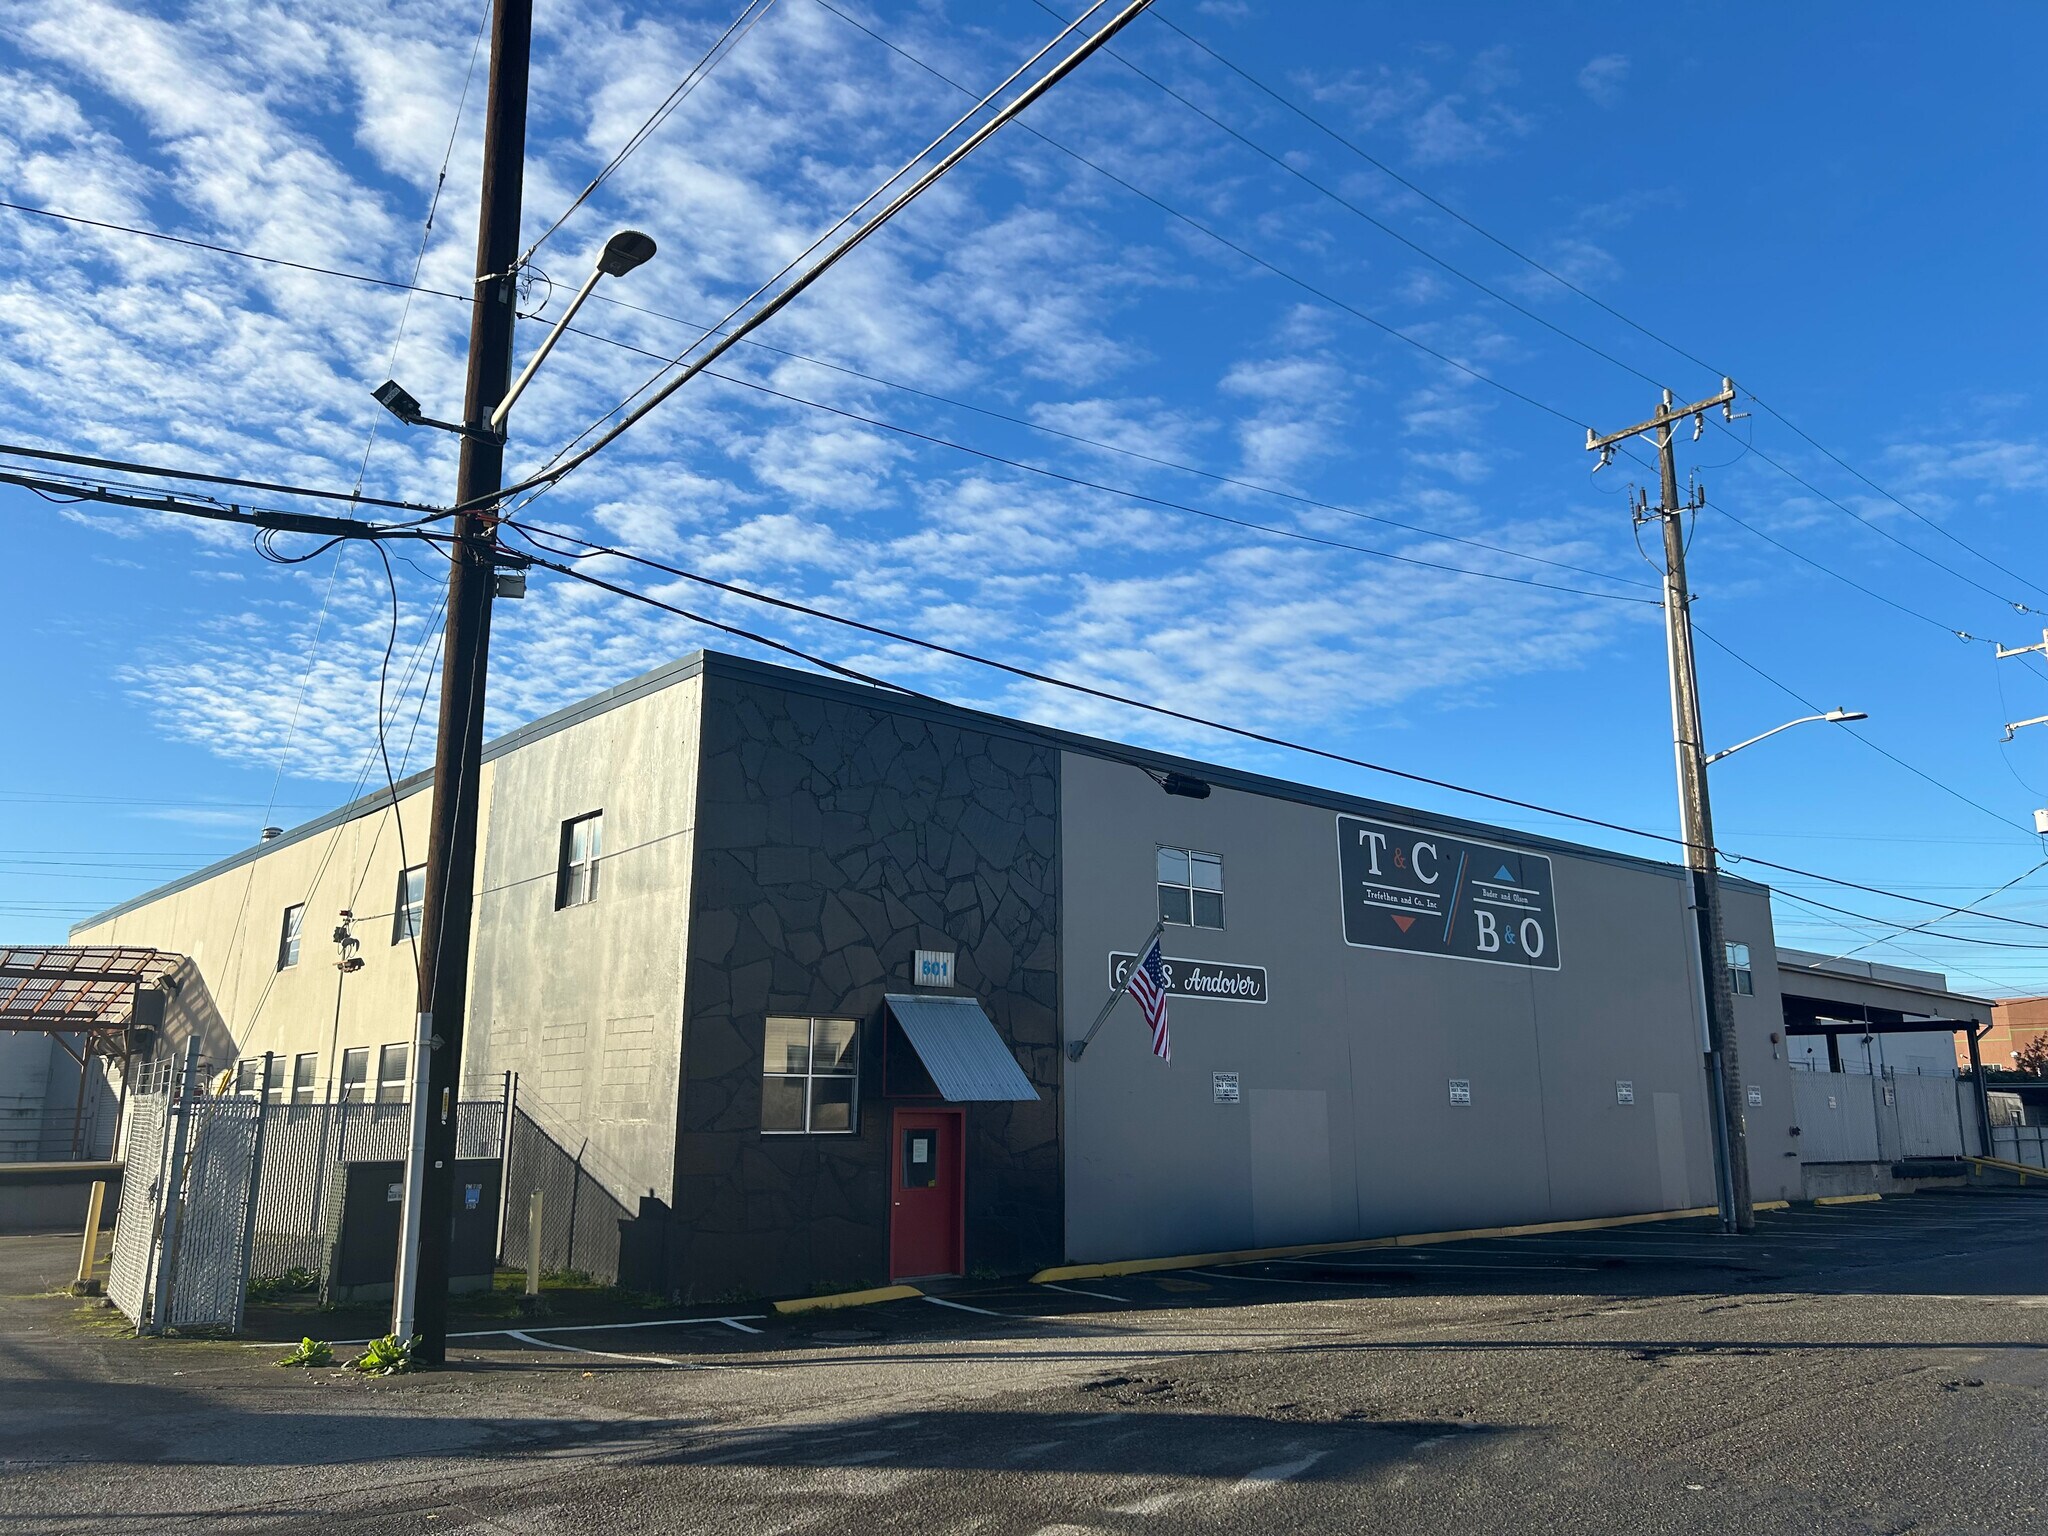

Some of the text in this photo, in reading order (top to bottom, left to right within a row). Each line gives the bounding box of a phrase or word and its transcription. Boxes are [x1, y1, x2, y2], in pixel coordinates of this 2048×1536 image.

[1366, 889, 1399, 903] Trefethen
[1400, 895, 1412, 905] and
[1500, 892, 1511, 901] and
[922, 960, 947, 977] 601
[1184, 967, 1260, 996] Andover
